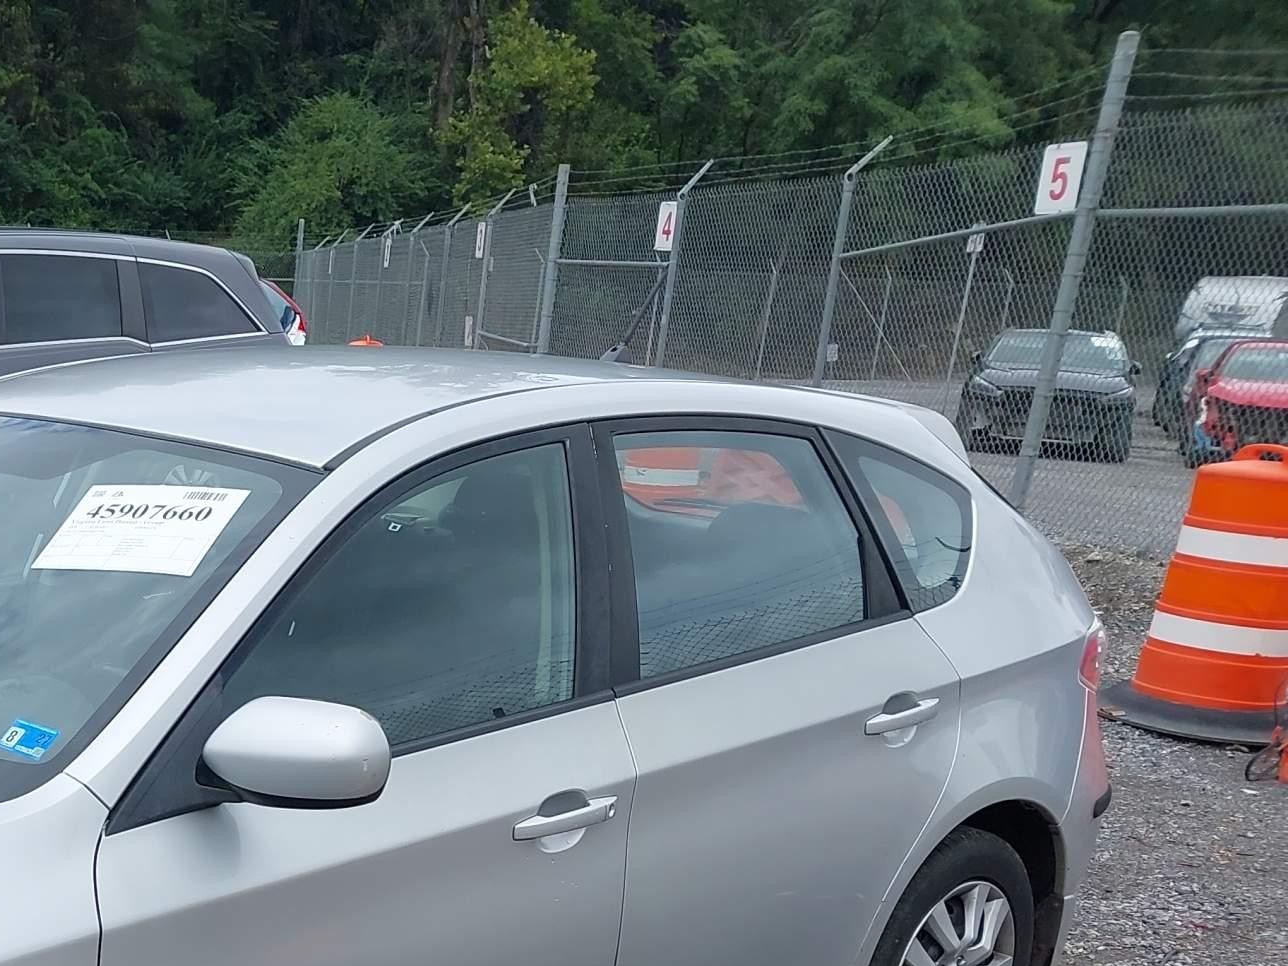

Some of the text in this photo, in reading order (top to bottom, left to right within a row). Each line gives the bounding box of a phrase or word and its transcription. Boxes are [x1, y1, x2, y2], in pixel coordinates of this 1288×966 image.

[1049, 157, 1072, 200] 5
[662, 211, 672, 241] 4
[86, 504, 213, 521] 45907660
[6, 730, 18, 742] 8
